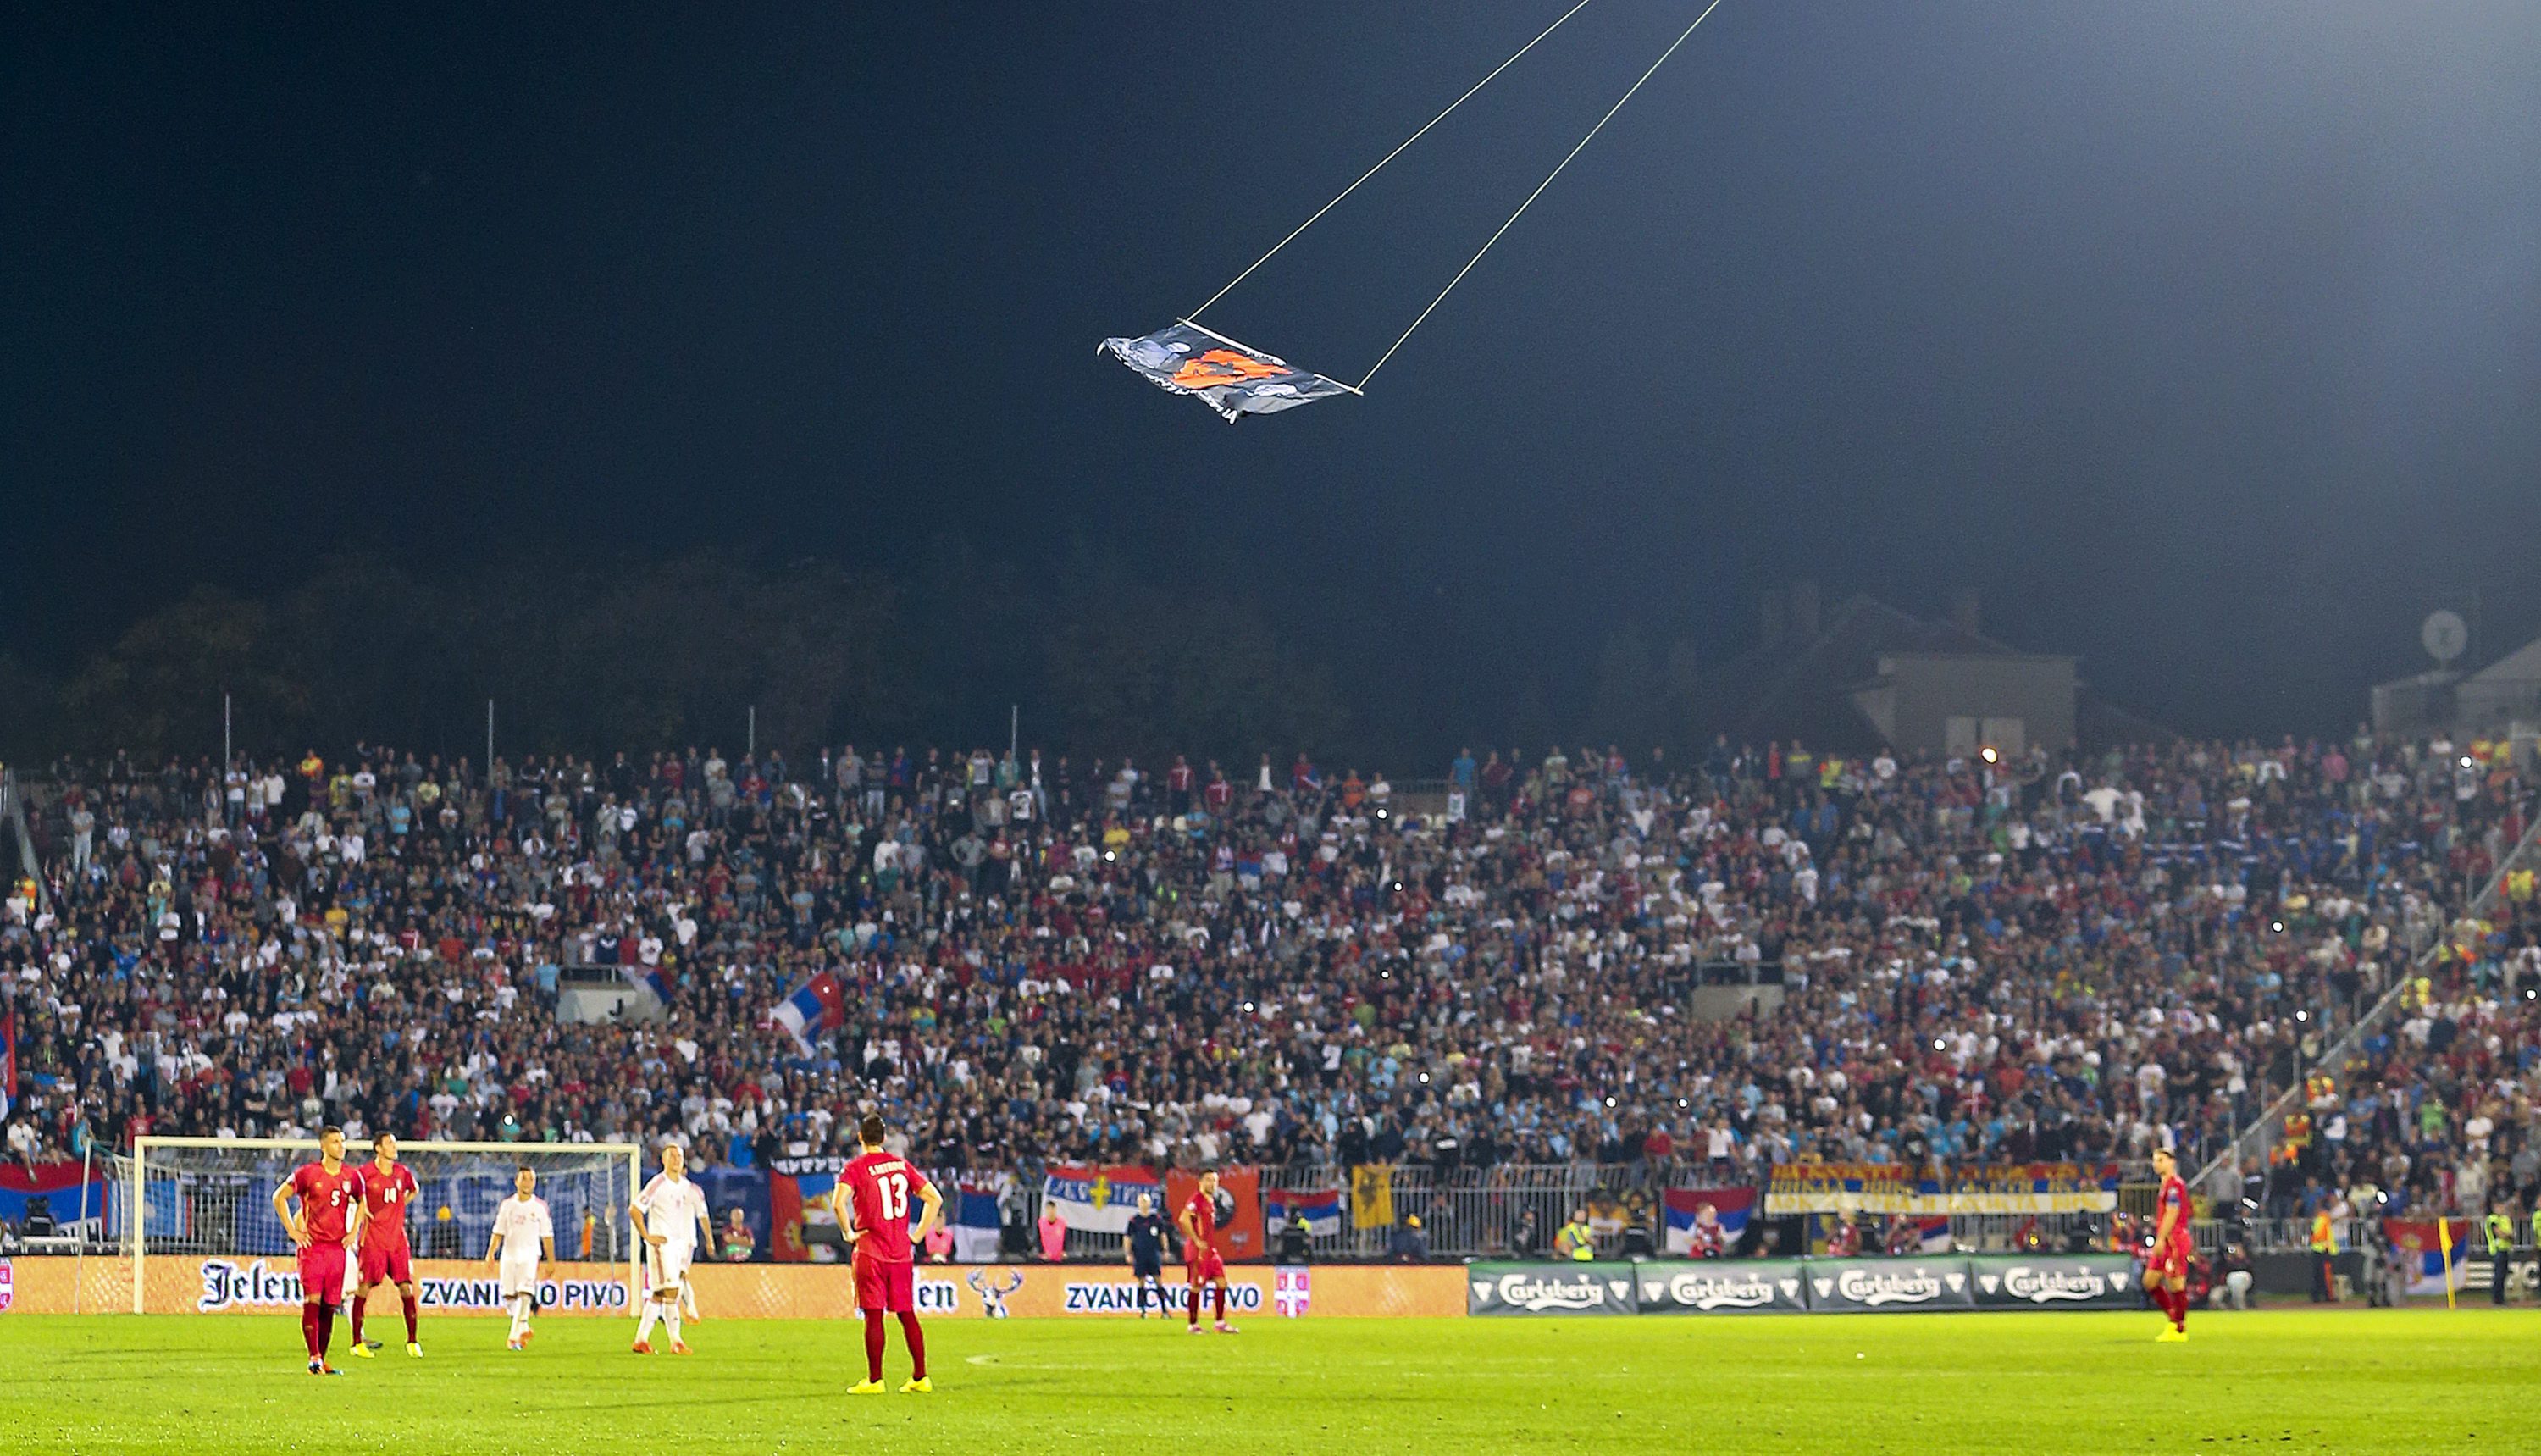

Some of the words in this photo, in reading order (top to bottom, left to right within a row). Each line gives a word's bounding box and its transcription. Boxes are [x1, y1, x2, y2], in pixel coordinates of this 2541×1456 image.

[330, 1188, 340, 1207] 5
[877, 1172, 910, 1221] 13
[201, 1260, 303, 1307] Jelen
[565, 1284, 625, 1308] PIVO
[1498, 1272, 1604, 1312] Carlsberg
[1669, 1272, 1774, 1311] Carlsberg
[1838, 1267, 1942, 1306] Carlsberg
[2003, 1265, 2106, 1304] Carlsberg
